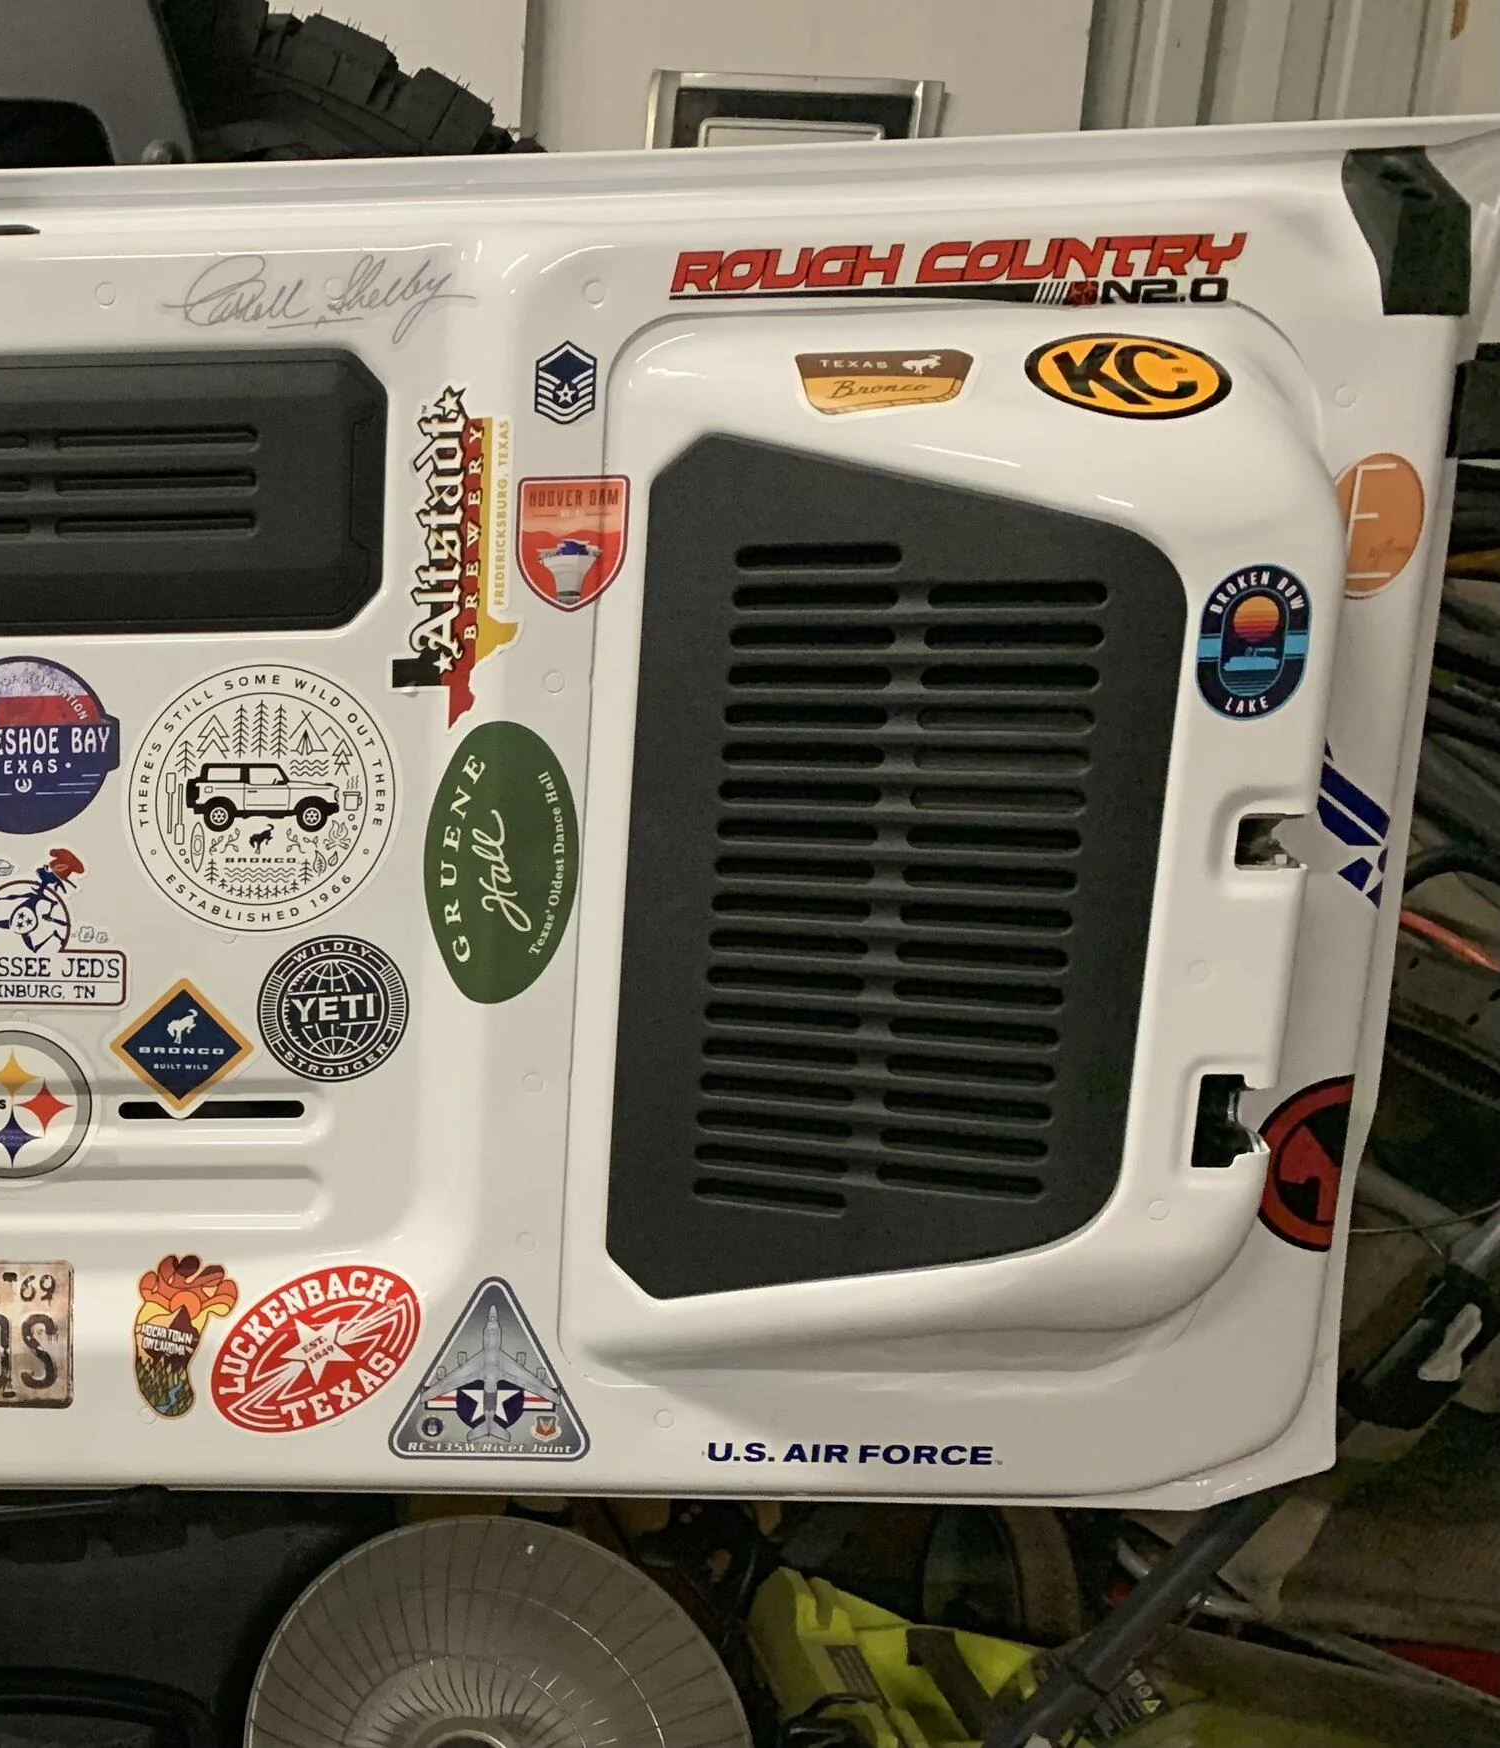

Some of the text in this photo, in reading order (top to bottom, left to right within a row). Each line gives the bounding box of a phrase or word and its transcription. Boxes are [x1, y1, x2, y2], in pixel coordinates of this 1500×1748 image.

[670, 232, 1248, 293] ROUGH COUNTRY
[819, 358, 889, 370] TEXAS
[1051, 341, 1201, 407] KC
[826, 379, 933, 400] Bronco
[497, 419, 510, 467] TEXAS
[528, 488, 620, 508] HOOVER DAM
[462, 424, 484, 641] BREWERY
[1208, 570, 1271, 615] BROKEN
[1224, 694, 1270, 715] LAKE
[70, 726, 111, 754] BAY
[138, 673, 387, 828] THERE'S STILL SOME WILD OUT THERE
[537, 770, 559, 805] Hall
[552, 806, 566, 857] Dance
[224, 856, 298, 864] BRONCO
[439, 753, 487, 964] GRUENE
[471, 808, 532, 933] Hall
[548, 858, 566, 907] Oldest
[164, 873, 353, 924] ESTABLISHED 1966
[292, 941, 373, 963] WILDLY
[60, 957, 121, 979] JED'S
[73, 985, 96, 999] TN
[290, 992, 376, 1023] YETI
[137, 1045, 225, 1056] BRONCO
[283, 1042, 390, 1076] STRONGER
[153, 1062, 209, 1071] BUILT WILD
[19, 1274, 57, 1303] 69
[218, 1269, 396, 1396] LUCKENBACH
[300, 1335, 328, 1354] EST.
[308, 1344, 335, 1364] 1849
[280, 1350, 398, 1429] TEXAS
[407, 1441, 573, 1455] RC-135W Rivet Joint
[706, 1442, 994, 1466] U.S. AIR FORCE
